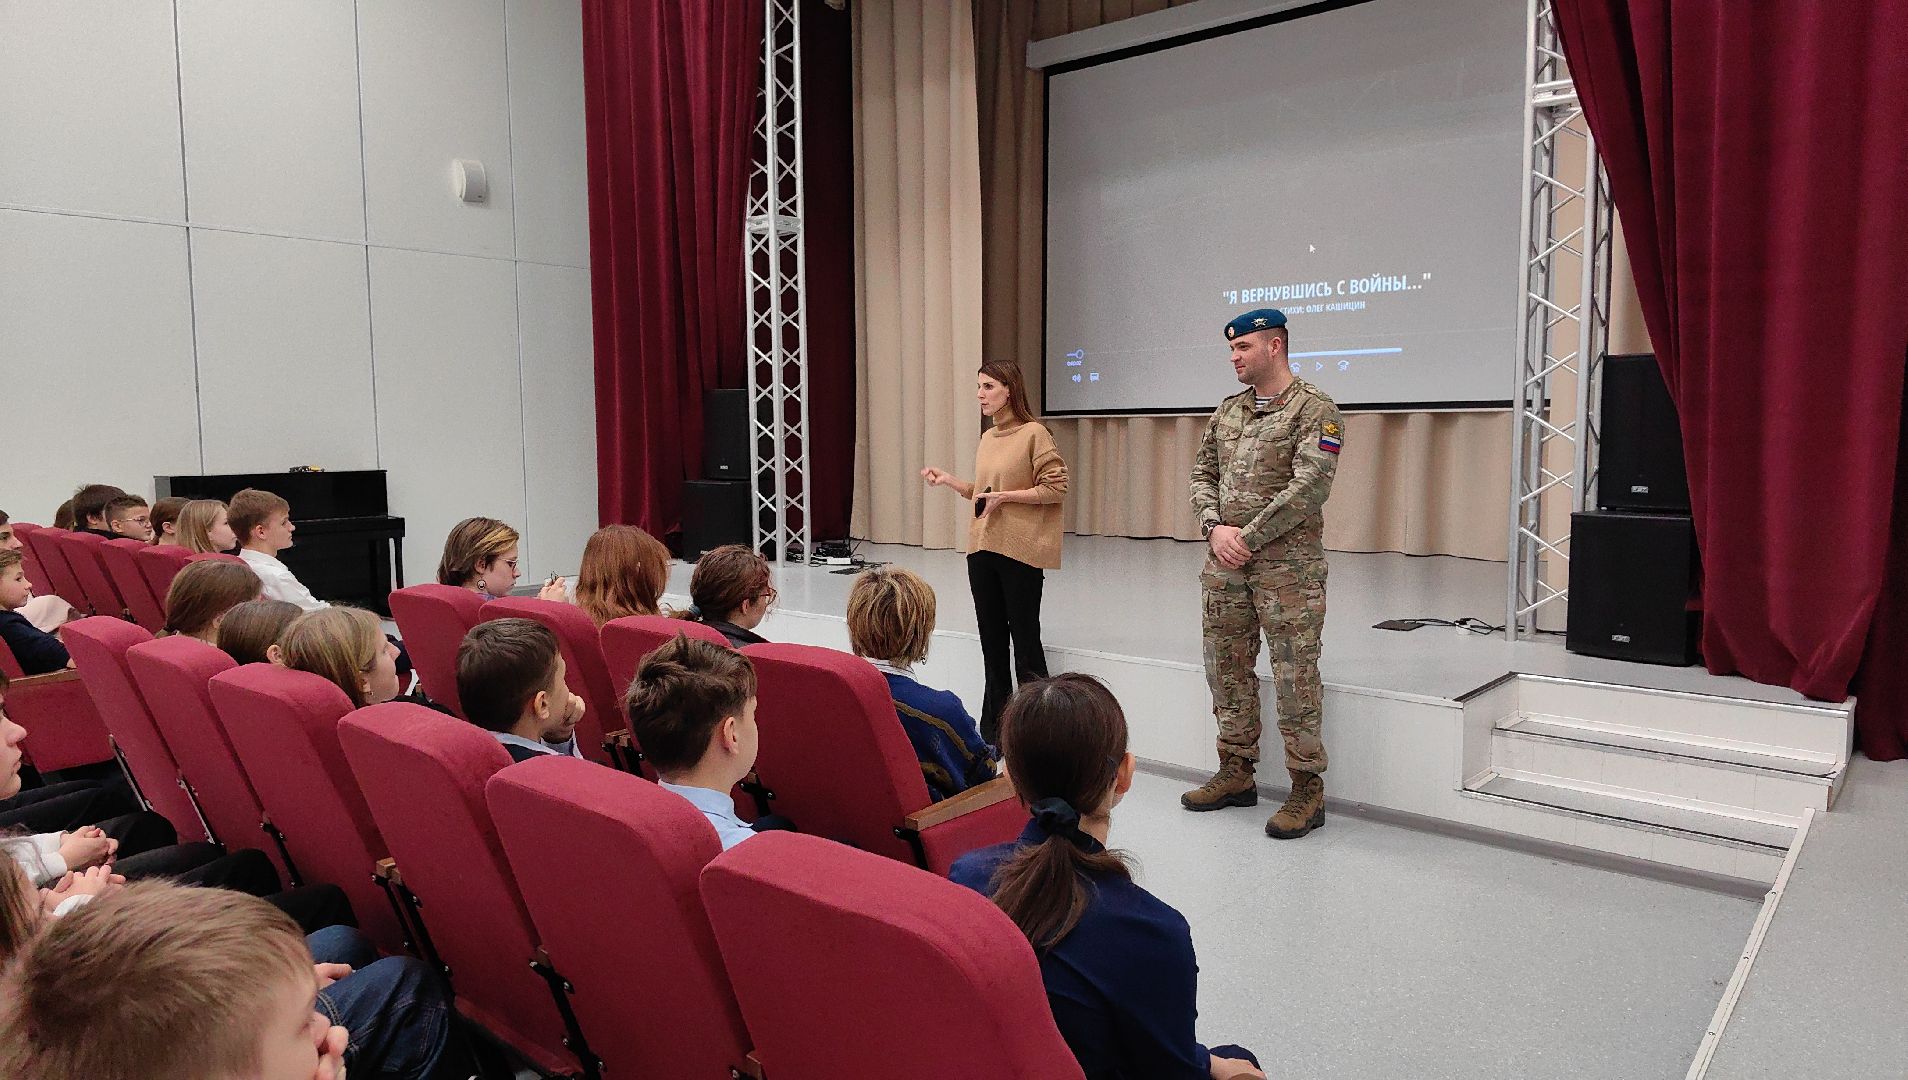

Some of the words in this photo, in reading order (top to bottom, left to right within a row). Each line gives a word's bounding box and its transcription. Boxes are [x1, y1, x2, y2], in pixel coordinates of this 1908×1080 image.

[1222, 289, 1238, 305] "Я
[1241, 281, 1332, 304] ВЕРНУВШИСЬ
[1336, 280, 1346, 296] С
[1306, 303, 1325, 313] ОЛЕГ
[1326, 300, 1366, 312] КАШИЦИН
